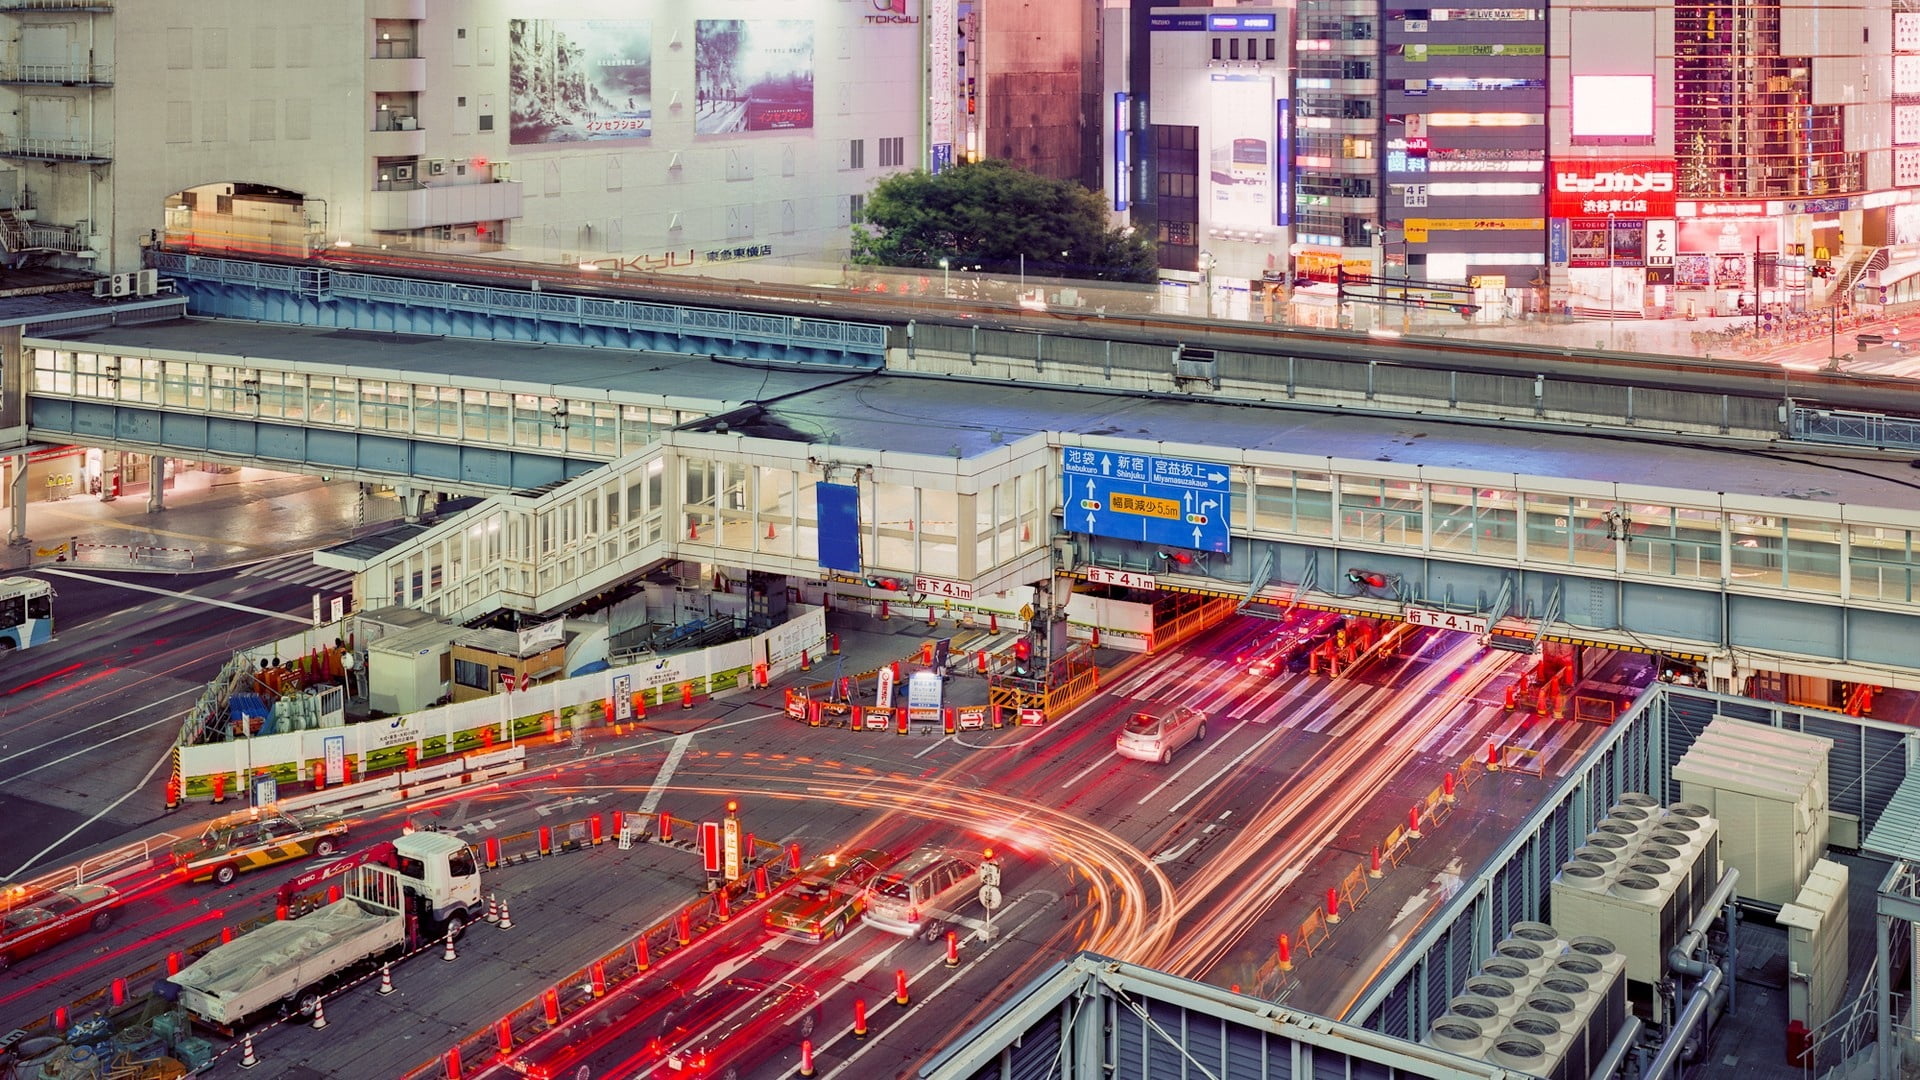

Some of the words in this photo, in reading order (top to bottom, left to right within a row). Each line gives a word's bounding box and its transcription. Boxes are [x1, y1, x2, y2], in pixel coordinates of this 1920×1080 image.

[865, 15, 919, 24] TOKYU
[586, 120, 644, 131] インセプション
[1388, 151, 1427, 172] 歯科
[1556, 172, 1673, 192] ビックカメラ
[1583, 200, 1647, 213] 渋谷東口店
[706, 245, 772, 262] 東急東横店
[1068, 450, 1095, 465] 池袋
[1117, 456, 1144, 471] 新宿
[1066, 463, 1098, 474] Ikebukuro
[1116, 470, 1145, 480] Shinjuku
[1155, 460, 1206, 479] 宮益坂上
[1153, 474, 1208, 488] Miyamasuzakaue
[298, 874, 315, 885] UNIC
